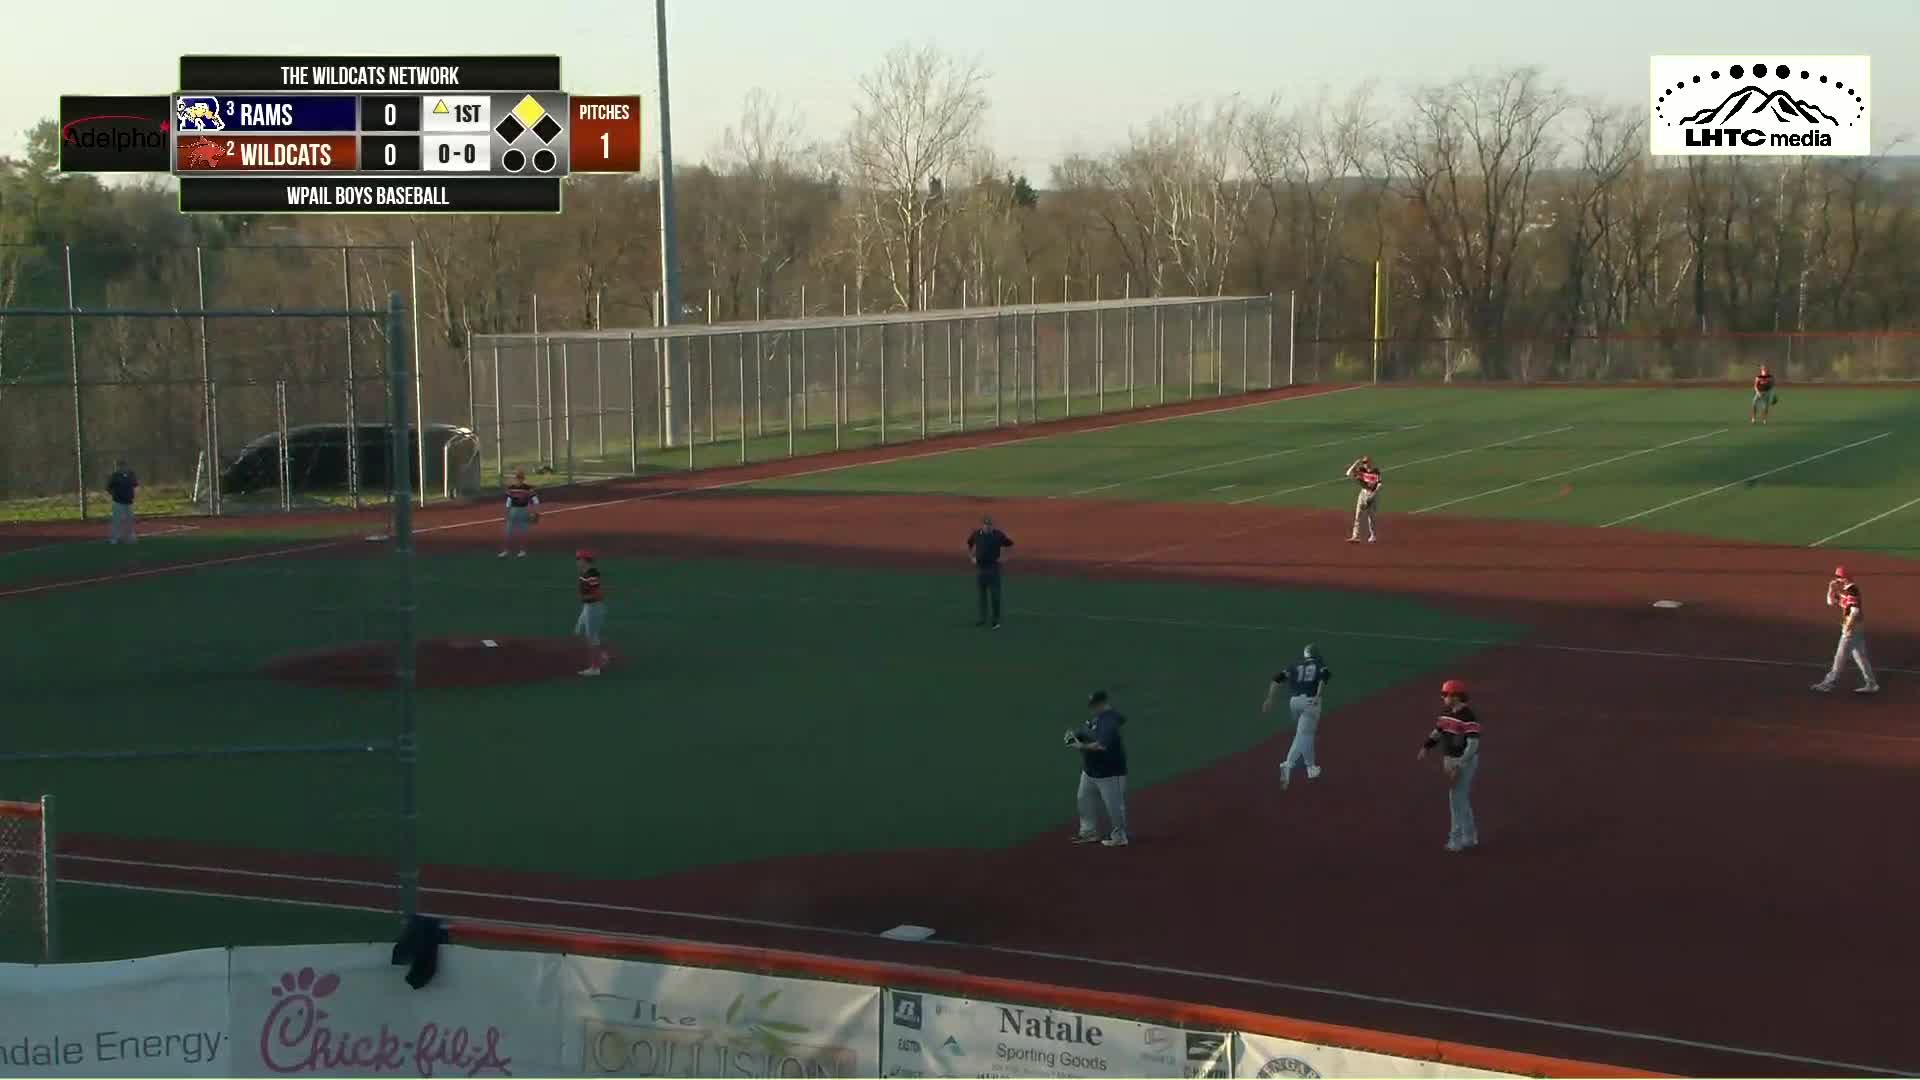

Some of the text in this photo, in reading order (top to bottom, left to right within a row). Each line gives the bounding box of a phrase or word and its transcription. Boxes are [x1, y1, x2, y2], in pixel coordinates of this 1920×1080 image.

[591, 992, 698, 1027] The
[999, 1007, 1104, 1046] Natale
[96, 1030, 222, 1064] Energy
[997, 1042, 1056, 1067] Sporting
[1060, 1049, 1108, 1072] Goods
